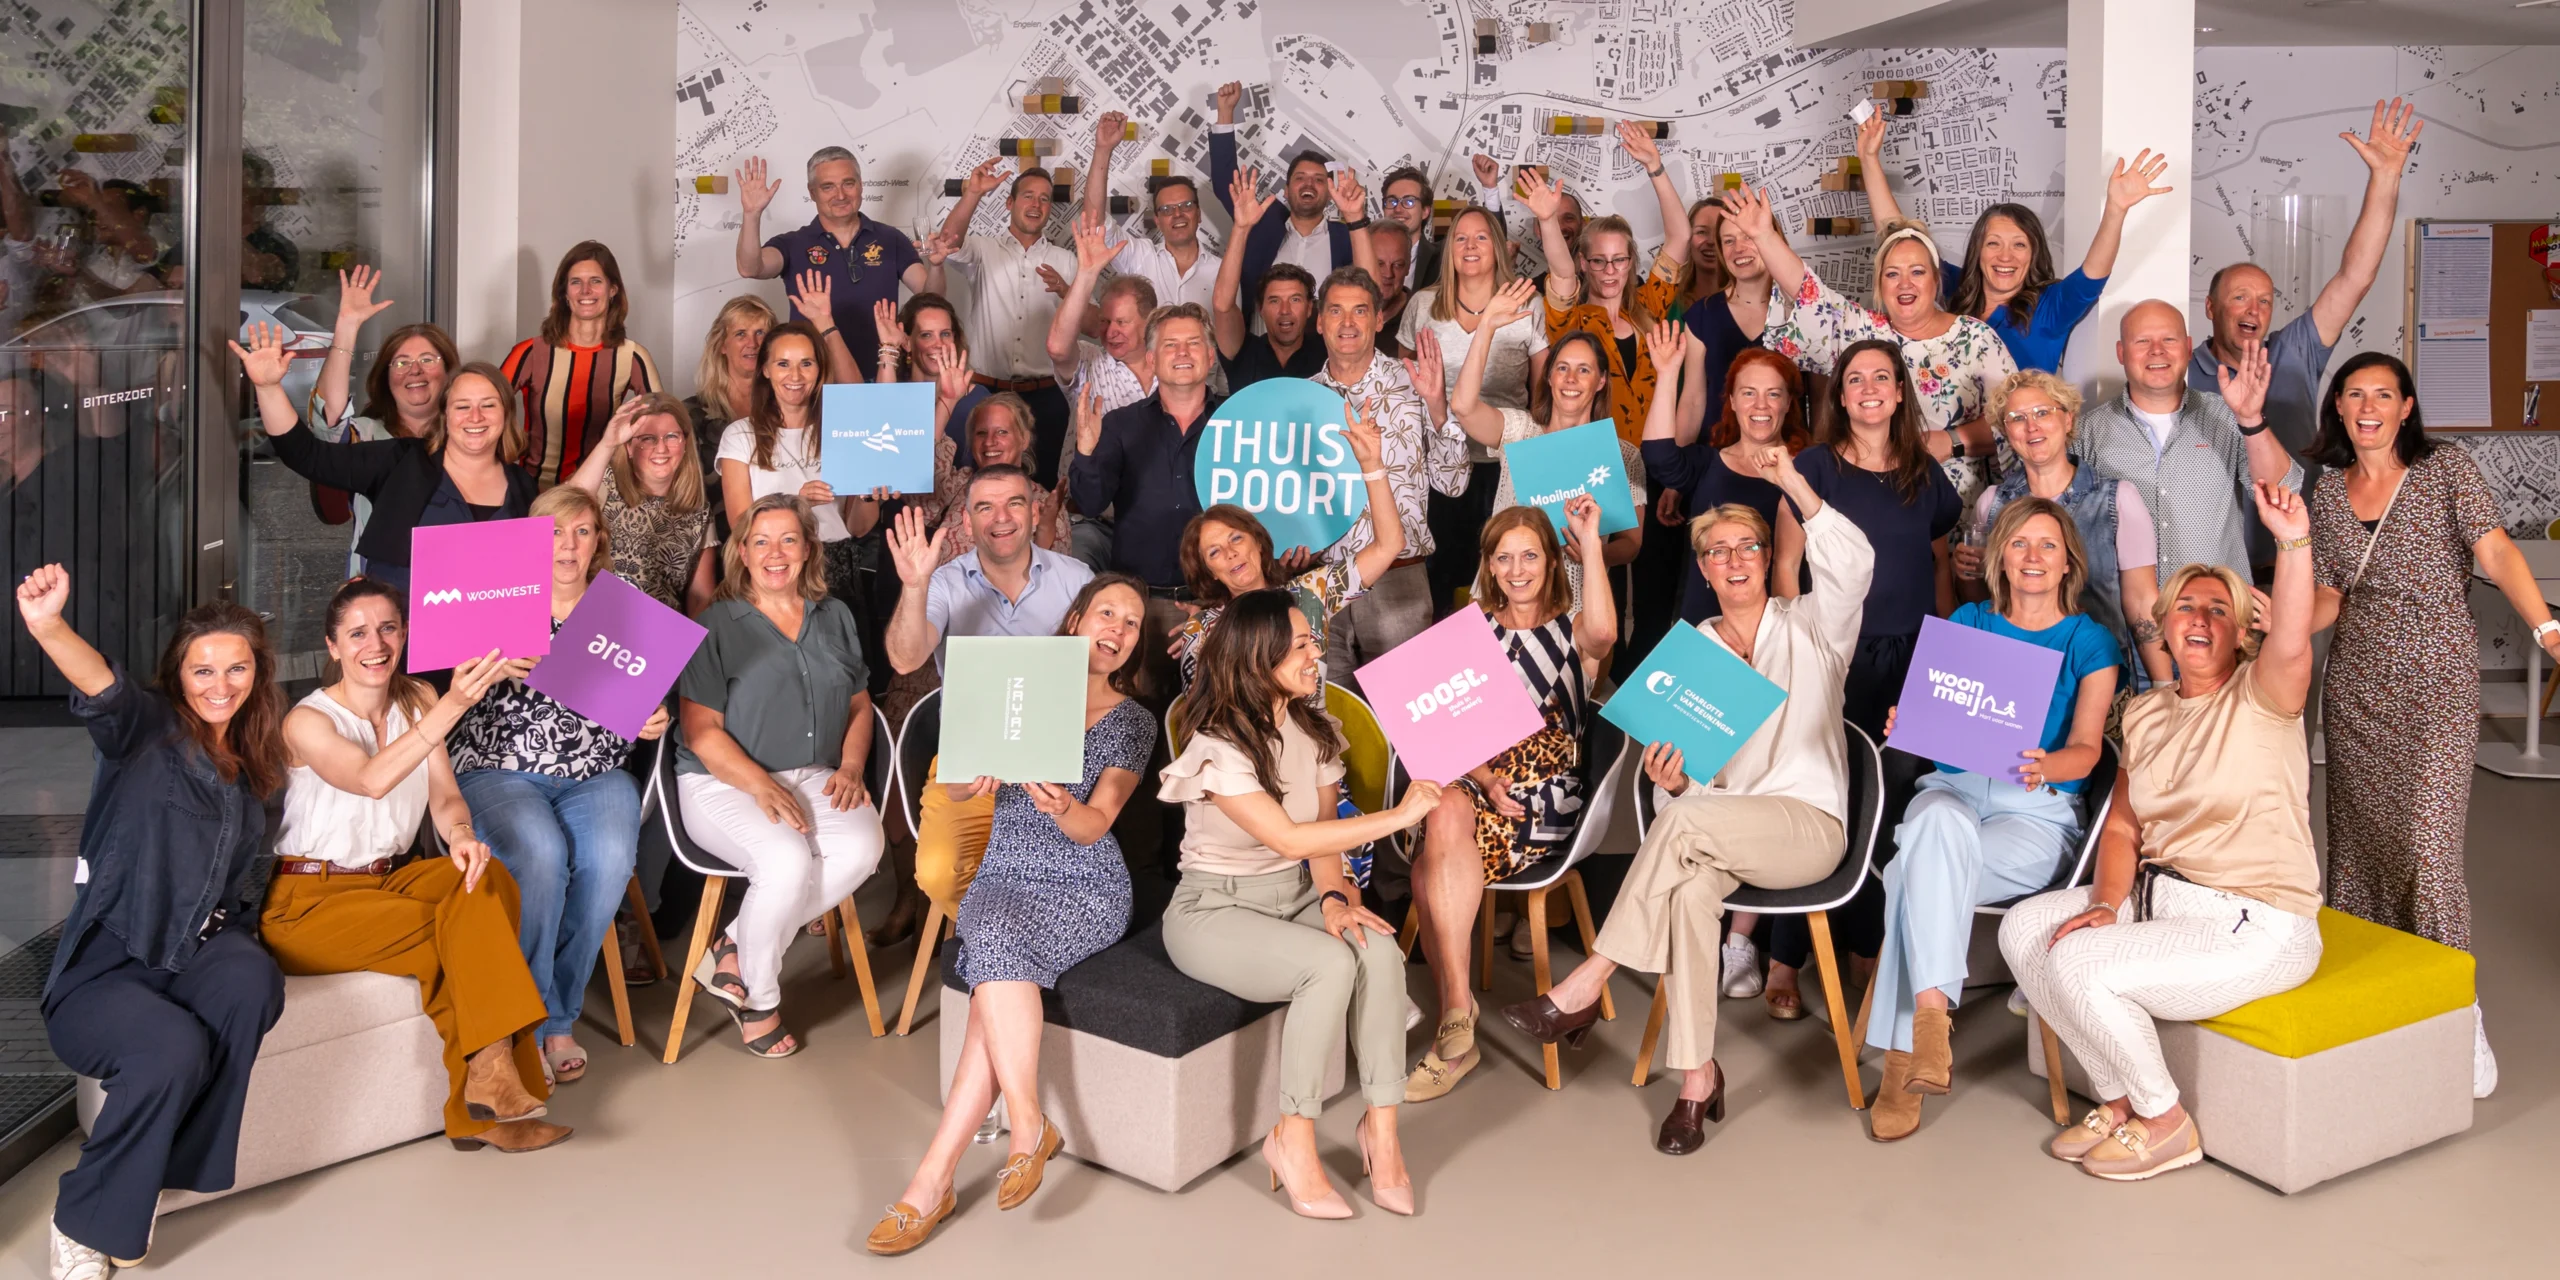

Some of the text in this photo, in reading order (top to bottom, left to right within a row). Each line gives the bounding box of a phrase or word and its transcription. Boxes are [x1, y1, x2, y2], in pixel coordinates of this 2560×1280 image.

[1013, 20, 1042, 29] Engelen
[1728, 93, 1768, 117] Stadionlaan
[1249, 142, 1288, 177] Rietveldenwe
[1690, 162, 1704, 201] Grobbendo
[2041, 189, 2065, 198] Hintha
[83, 387, 154, 409] BITTERZOET
[831, 428, 925, 438] Brabant Wonen
[1207, 419, 1345, 468] THUIS
[1210, 468, 1363, 516] POORT
[1529, 483, 1586, 506] Mooiland
[466, 584, 541, 602] WOONVESTE
[587, 633, 647, 677] area
[1928, 667, 1985, 697] woon
[1010, 677, 1025, 741] ZAYAZ
[1679, 694, 1736, 737] VAN BEUNINGEN
[1684, 688, 1725, 719] CHARLOTTE
[1932, 684, 1982, 717] meij
[1979, 712, 2023, 731] Hart voor wonen
